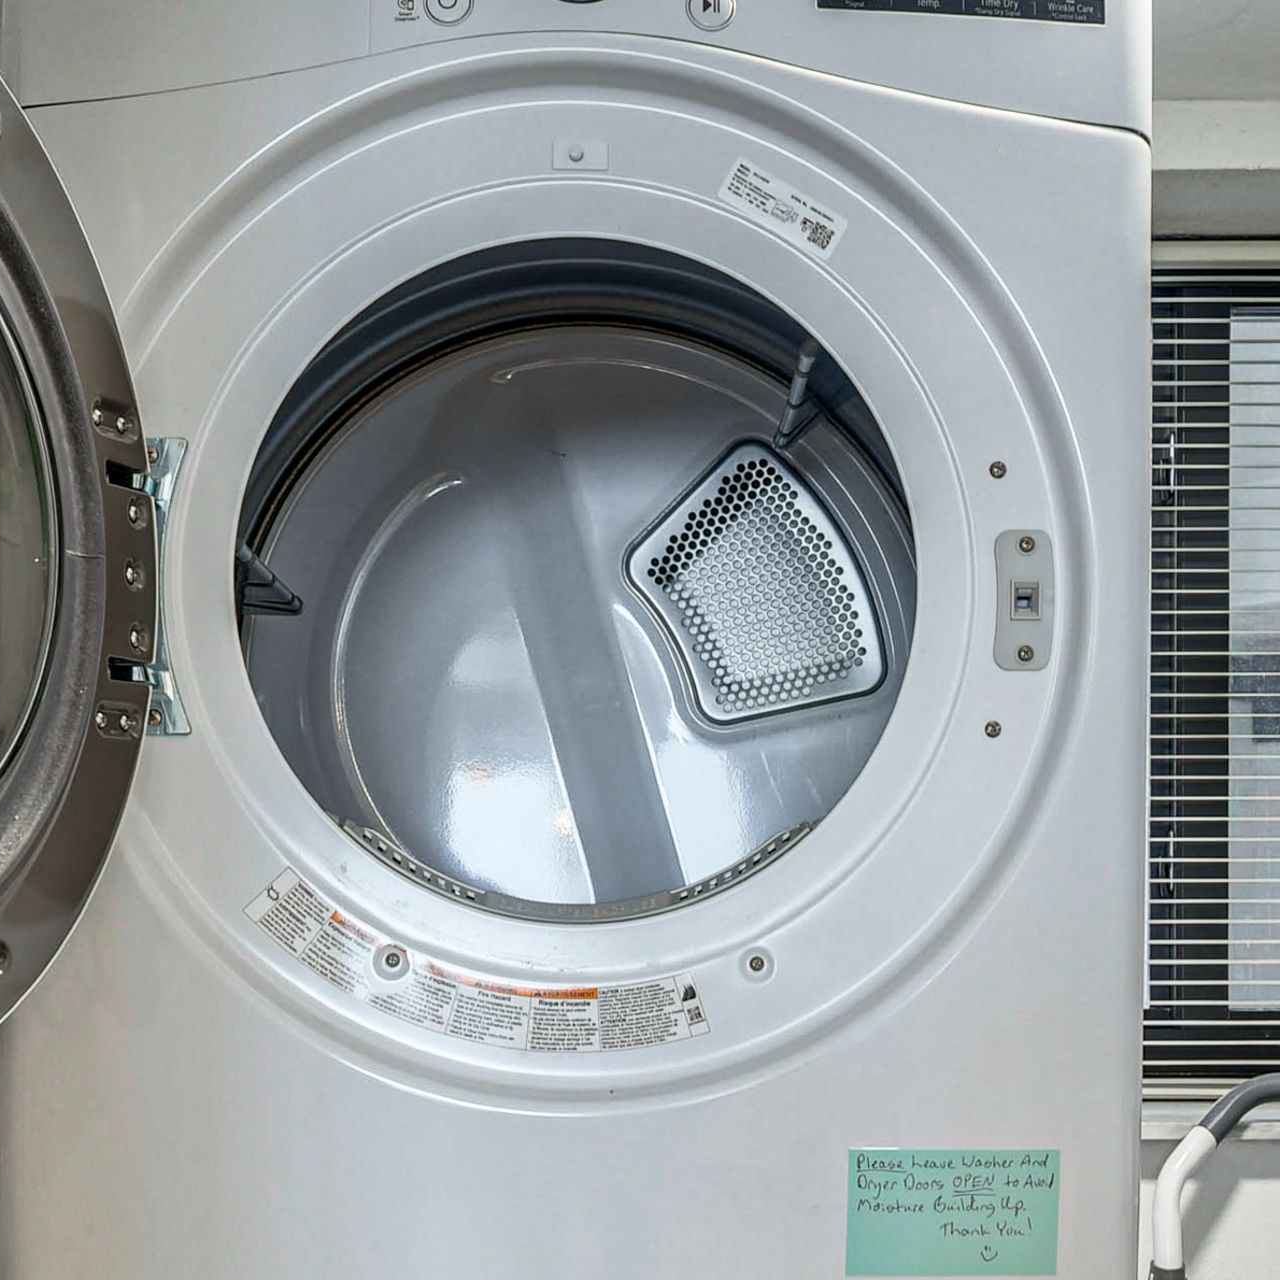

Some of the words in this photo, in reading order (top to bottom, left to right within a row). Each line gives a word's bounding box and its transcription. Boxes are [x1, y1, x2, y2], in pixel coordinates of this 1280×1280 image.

[1077, 4, 1094, 13] Care
[857, 1153, 904, 1170] Please
[912, 1155, 955, 1169] Leave
[962, 1154, 1014, 1169] Washer
[1021, 1153, 1049, 1168] And
[856, 1173, 898, 1200] Dryer
[904, 1173, 945, 1190] Doors
[953, 1175, 996, 1188] OPEN
[1005, 1174, 1020, 1188] to
[1023, 1173, 1055, 1190] Avoid
[856, 1199, 925, 1213] Moisture
[933, 1195, 997, 1218] Building
[939, 1221, 990, 1238] Thank
